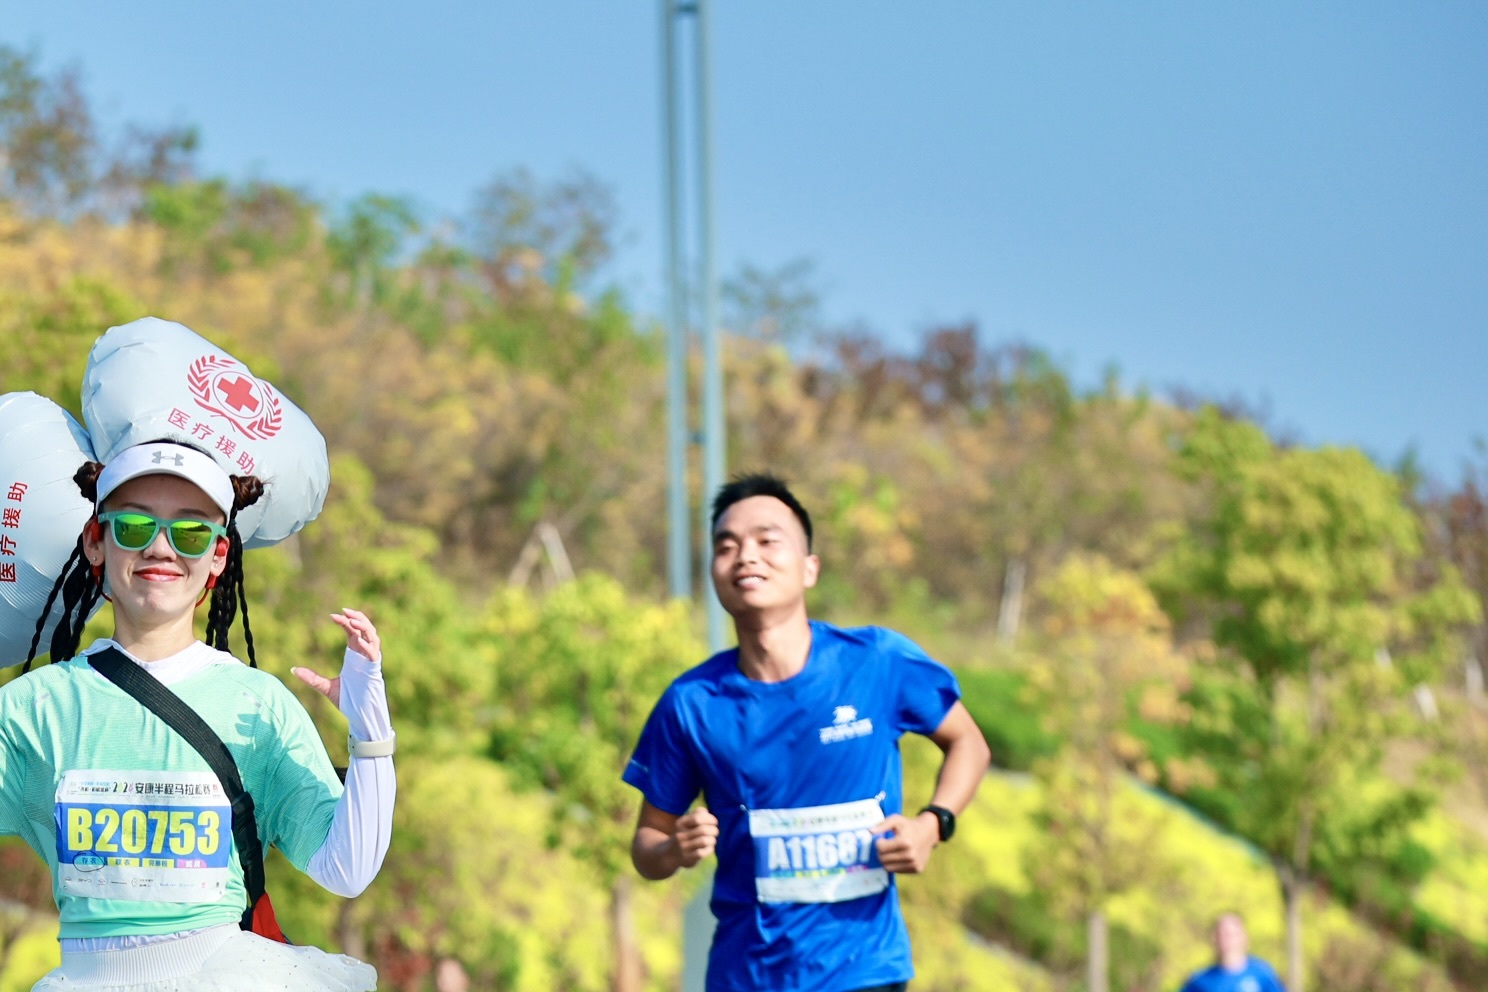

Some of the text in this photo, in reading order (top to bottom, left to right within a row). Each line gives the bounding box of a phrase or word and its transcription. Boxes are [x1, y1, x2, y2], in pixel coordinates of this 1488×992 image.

[167, 407, 256, 475] 医疗援助
[67, 808, 220, 855] B20753
